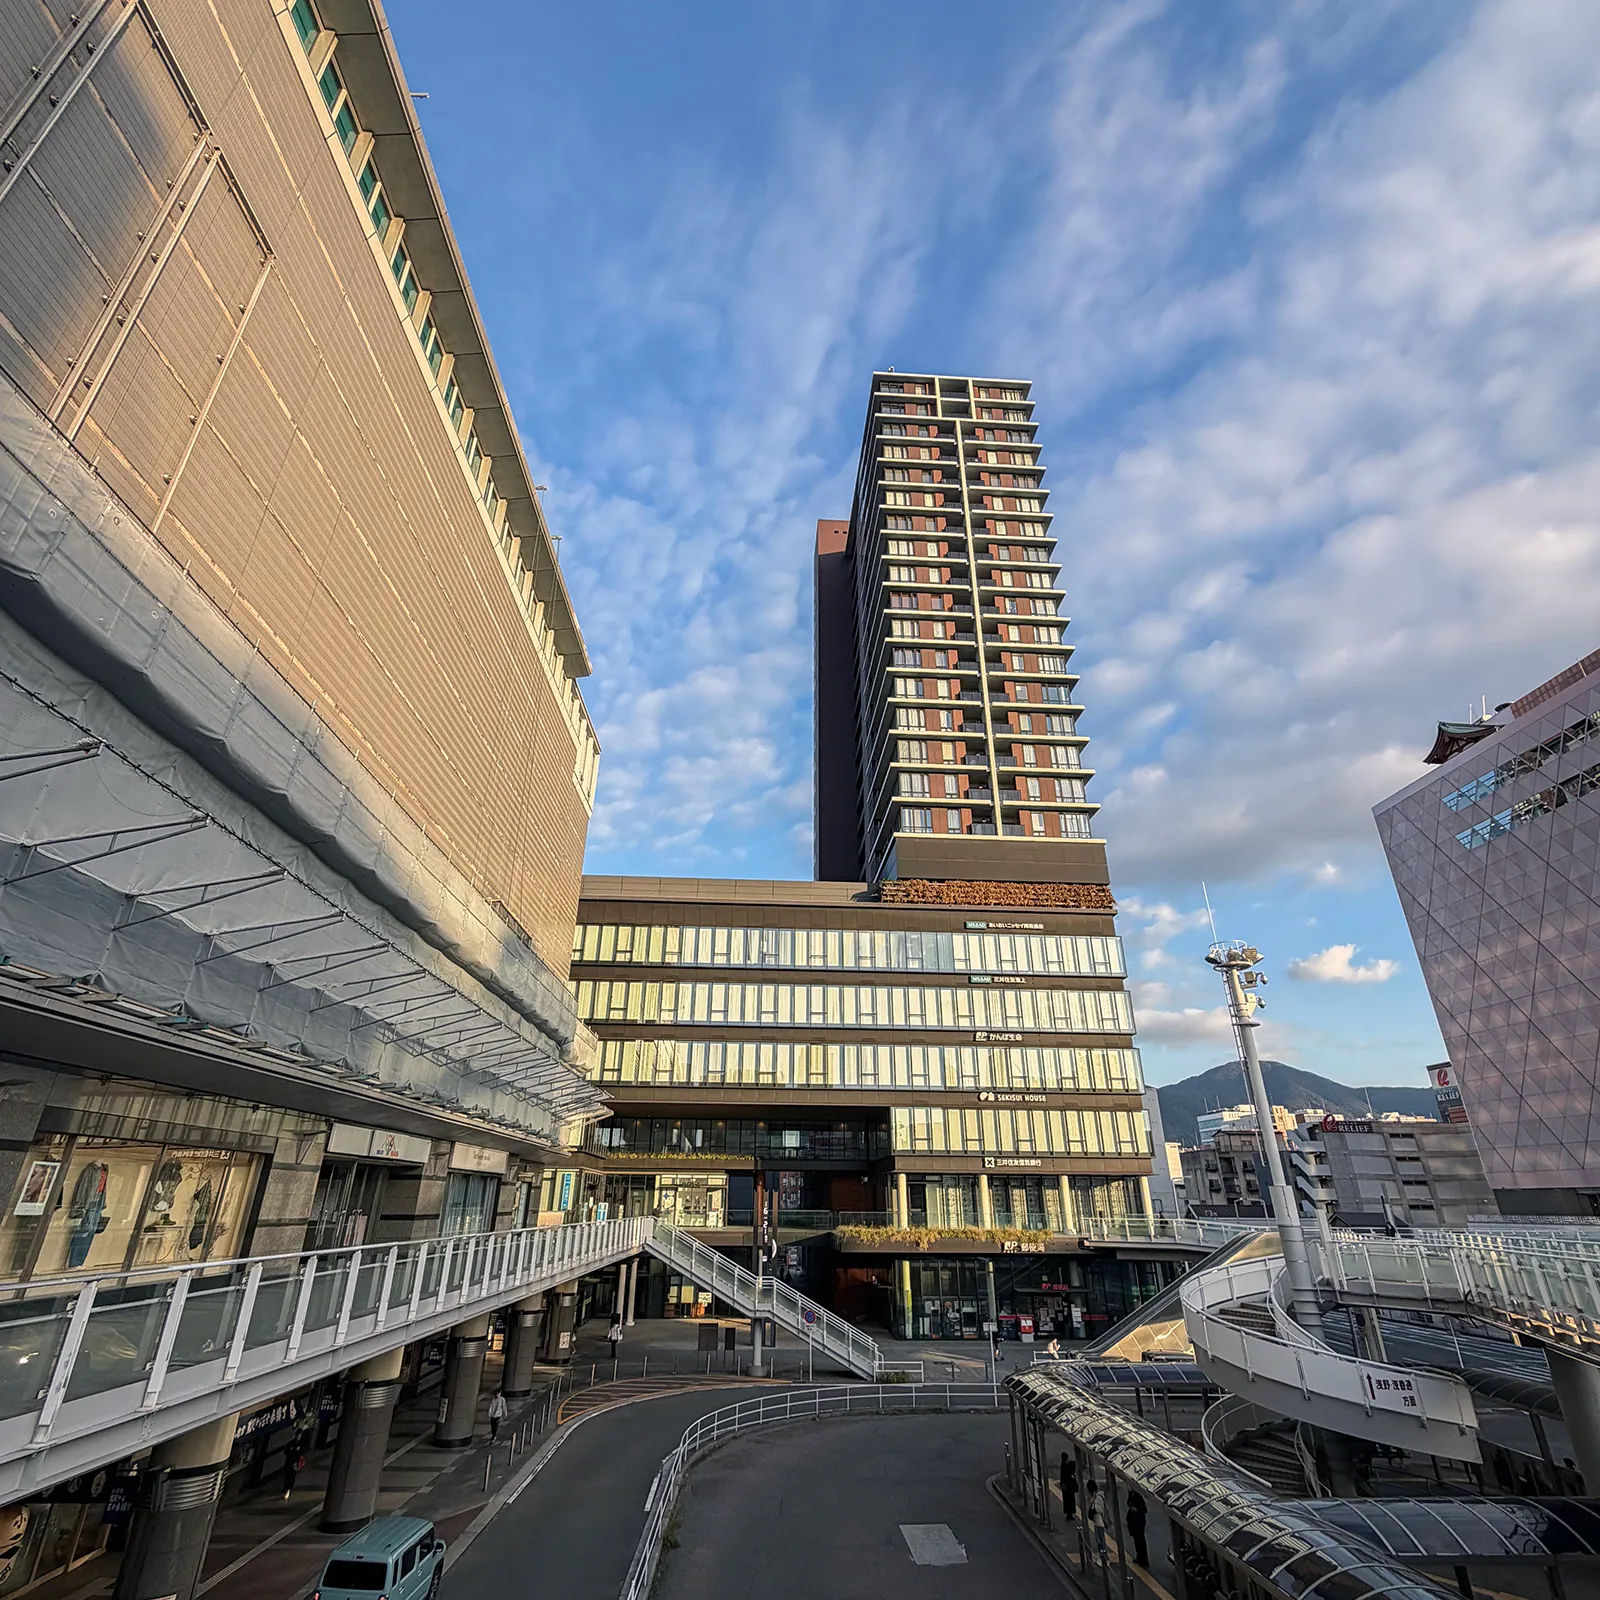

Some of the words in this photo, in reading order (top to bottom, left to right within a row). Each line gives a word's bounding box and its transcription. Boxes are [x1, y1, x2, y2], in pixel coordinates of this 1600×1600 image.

[990, 1033, 1022, 1041] かんぽ生命
[997, 1093, 1023, 1102] SEKISUI
[1025, 1094, 1047, 1102] HOUSE
[1437, 1092, 1460, 1102] RELIEF
[1402, 1395, 1417, 1407] 方面
